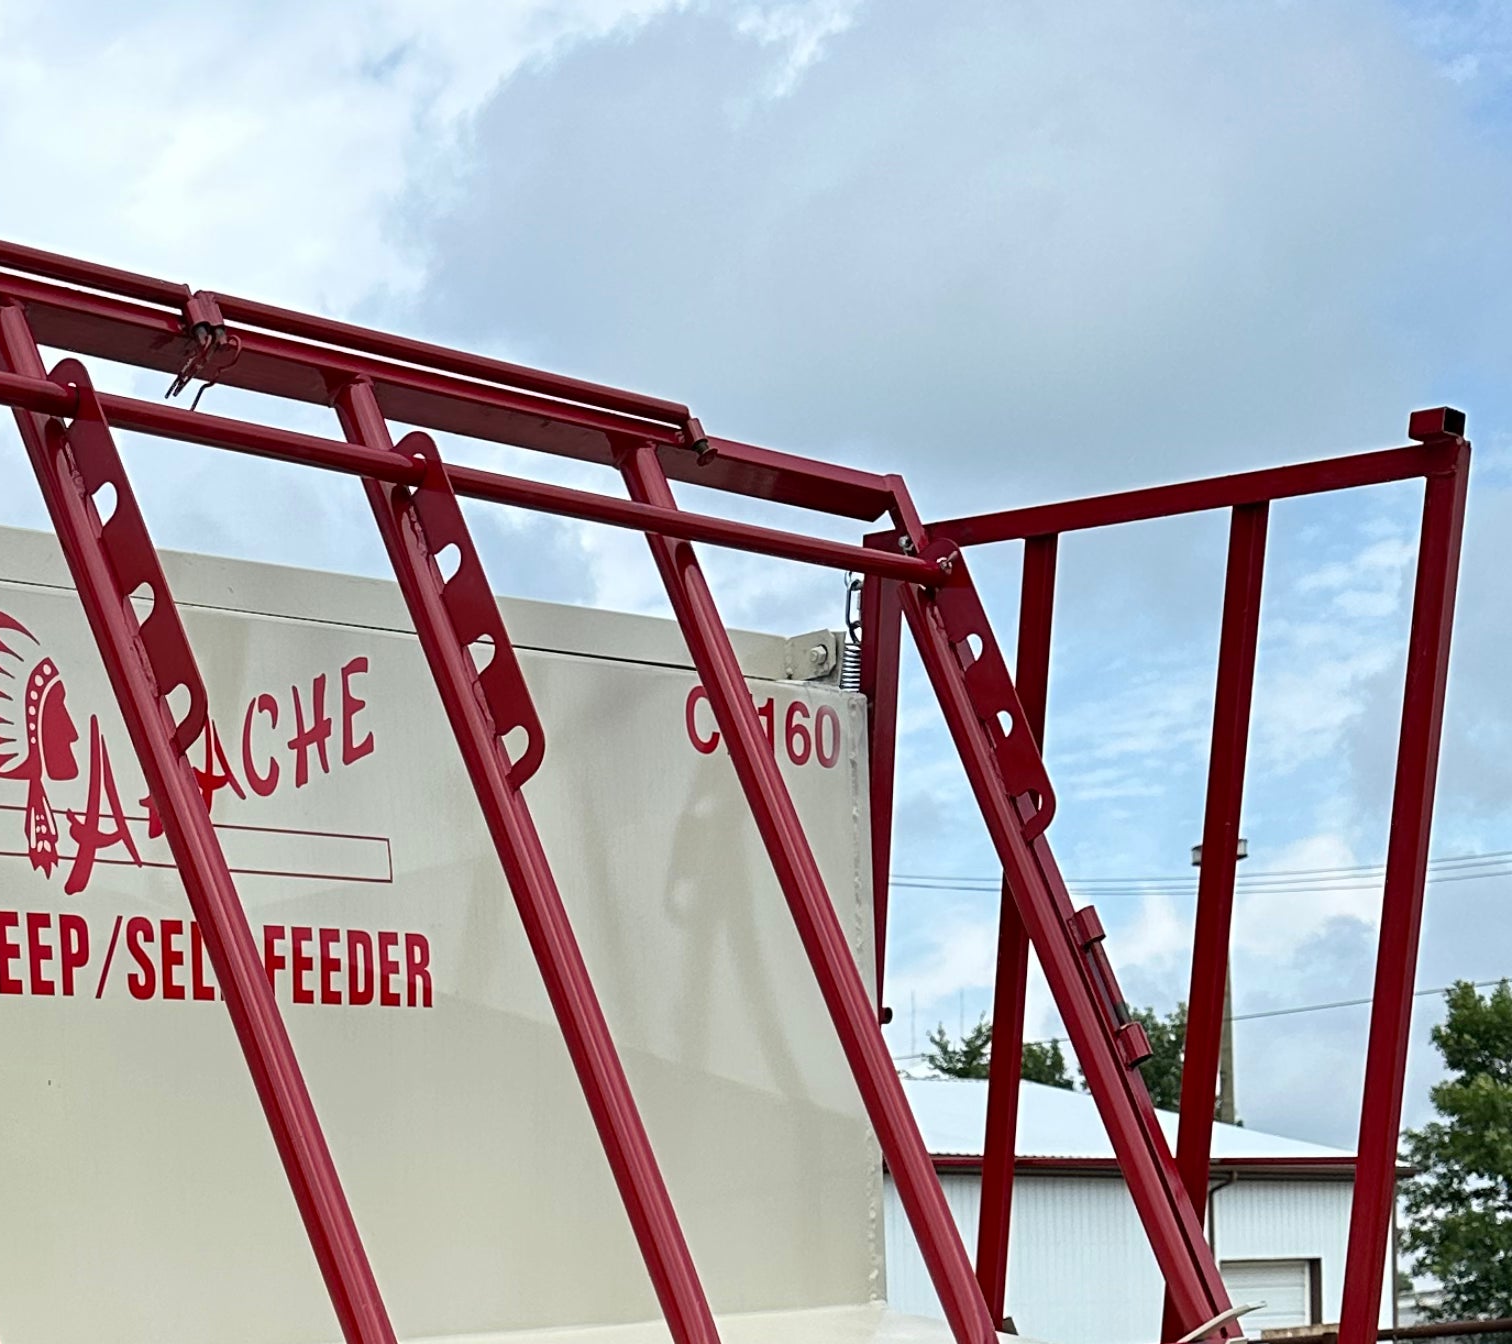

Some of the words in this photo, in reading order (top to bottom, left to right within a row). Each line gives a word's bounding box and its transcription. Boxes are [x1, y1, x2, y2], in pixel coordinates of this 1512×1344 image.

[685, 685, 841, 769] C160
[64, 656, 375, 895] AACHE
[263, 924, 433, 1008] FEEDER
